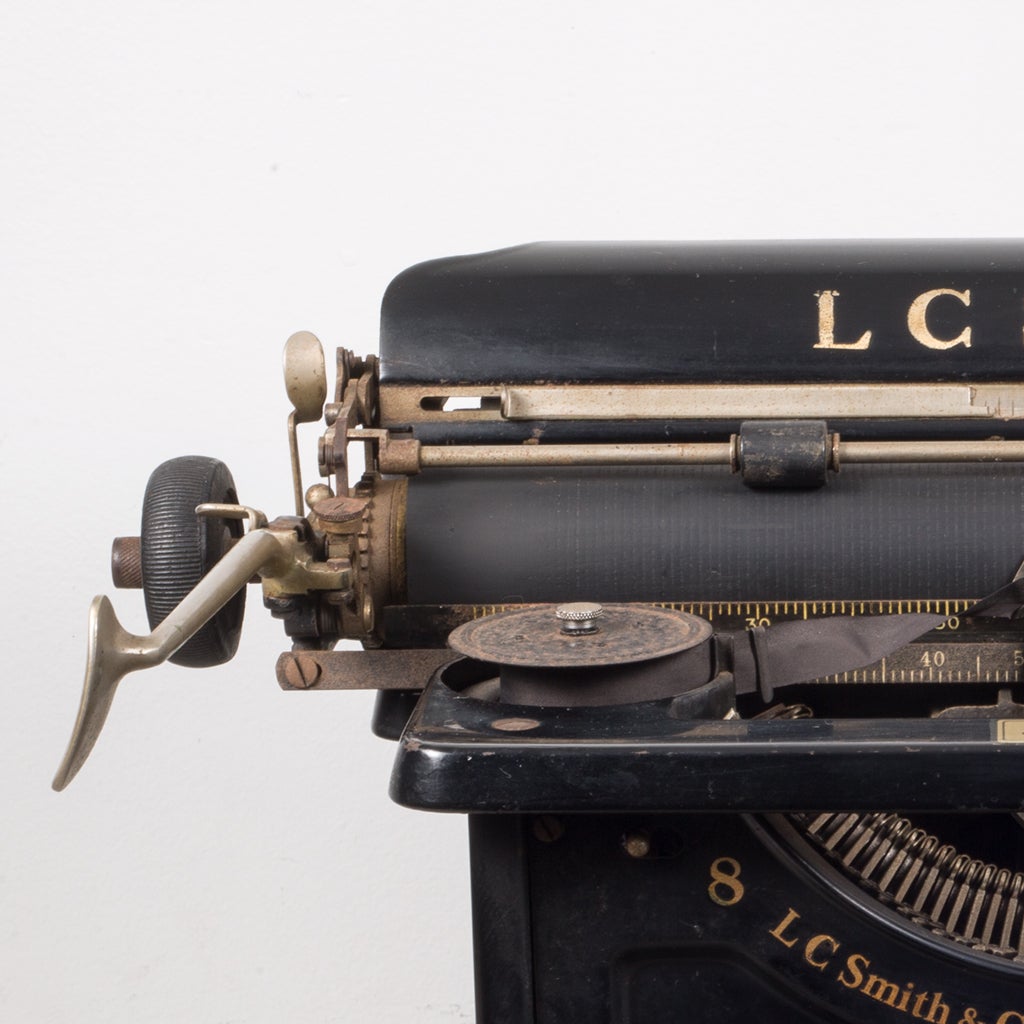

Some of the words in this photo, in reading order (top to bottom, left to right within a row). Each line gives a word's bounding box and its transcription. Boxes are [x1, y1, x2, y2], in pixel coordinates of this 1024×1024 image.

[812, 289, 872, 350] L
[907, 287, 972, 350] C
[920, 650, 946, 667] 40
[707, 856, 745, 907] 8
[769, 907, 801, 948] L
[804, 934, 840, 972] C
